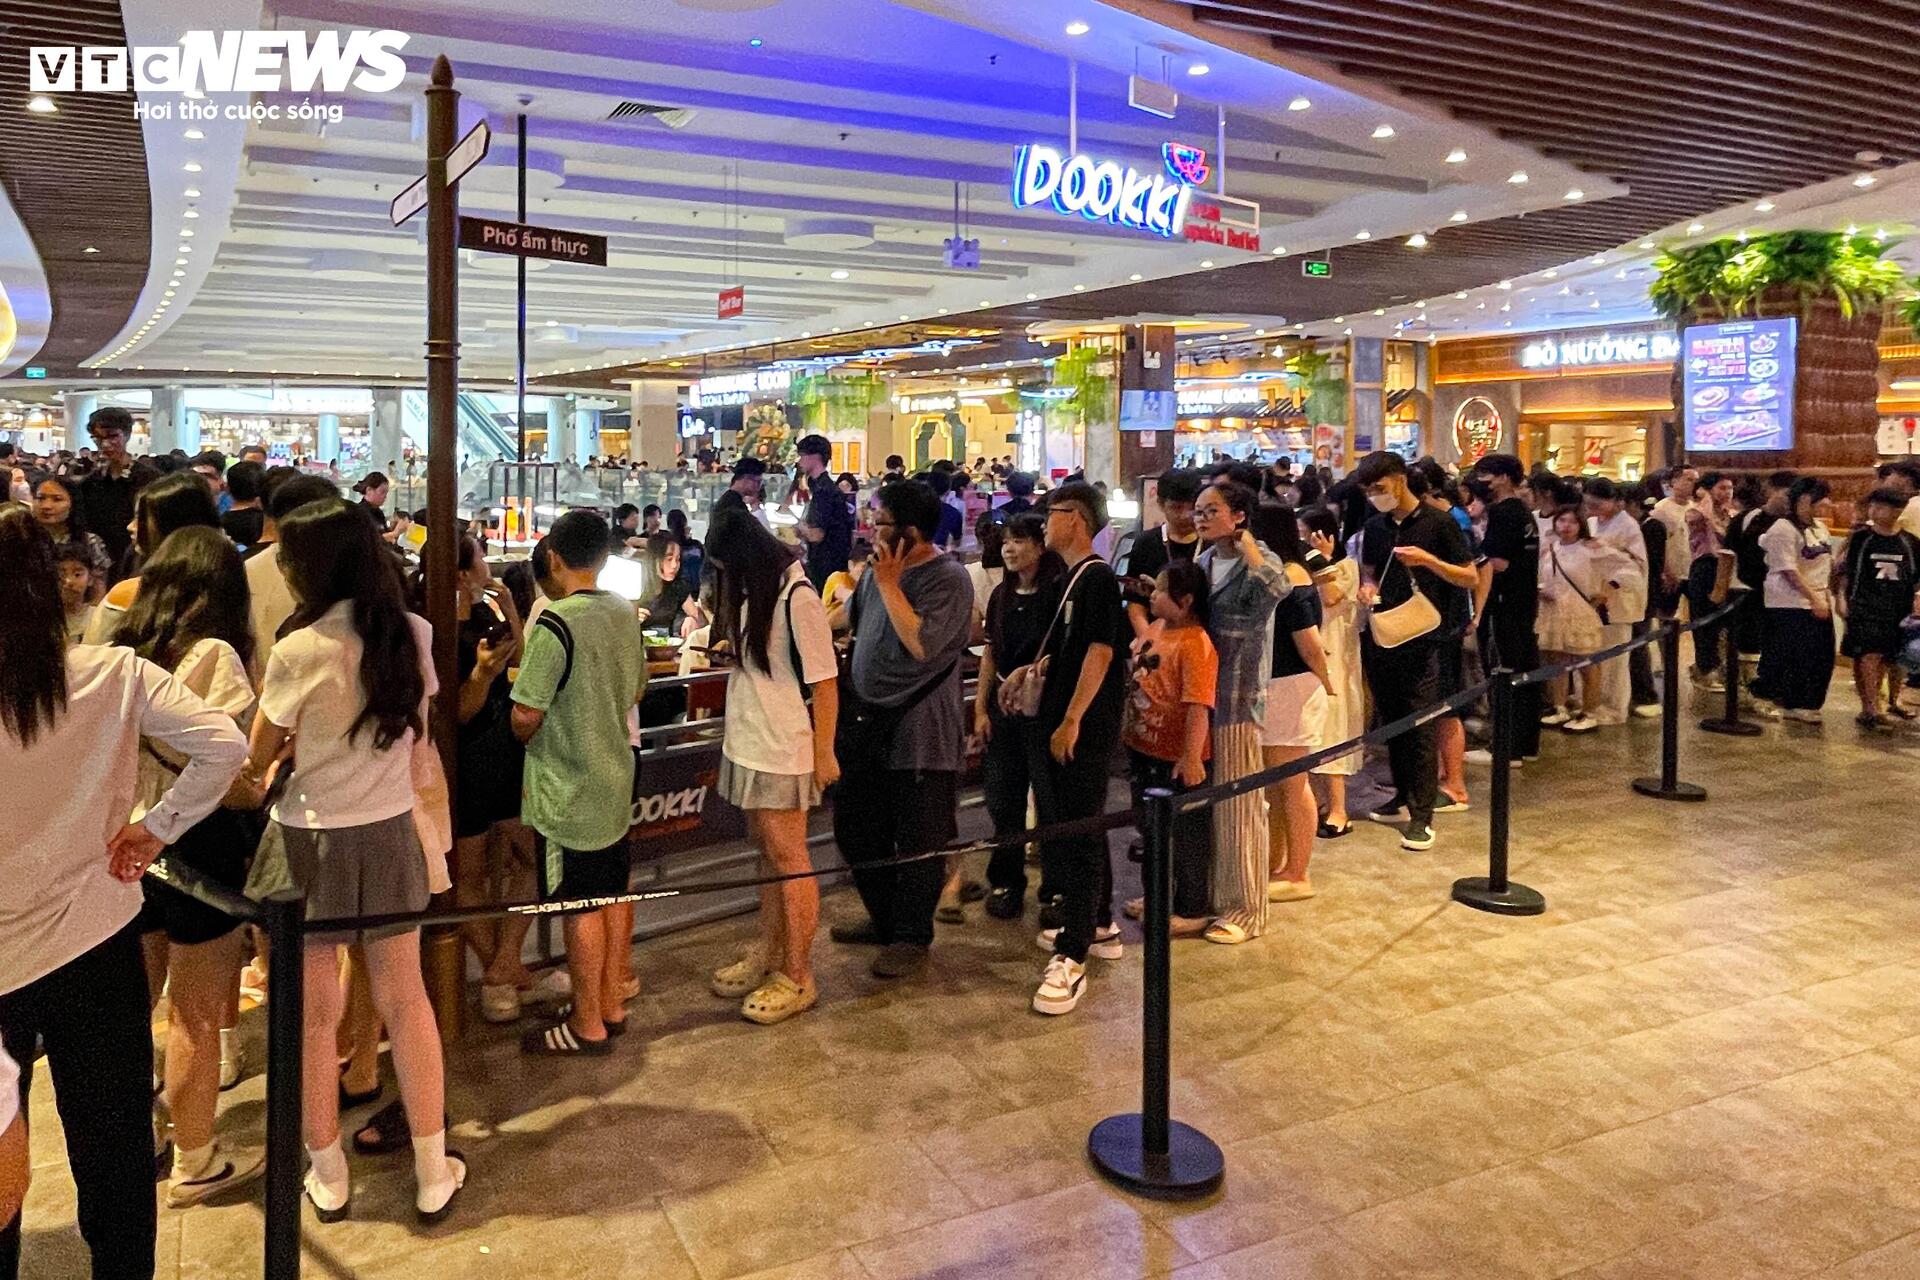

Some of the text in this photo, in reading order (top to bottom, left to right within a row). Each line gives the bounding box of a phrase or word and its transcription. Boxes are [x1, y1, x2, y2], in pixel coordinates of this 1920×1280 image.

[1018, 143, 1192, 236] DOOKKI
[483, 225, 518, 247] Phố
[551, 238, 589, 259] thực
[630, 785, 707, 826] OOKKI
